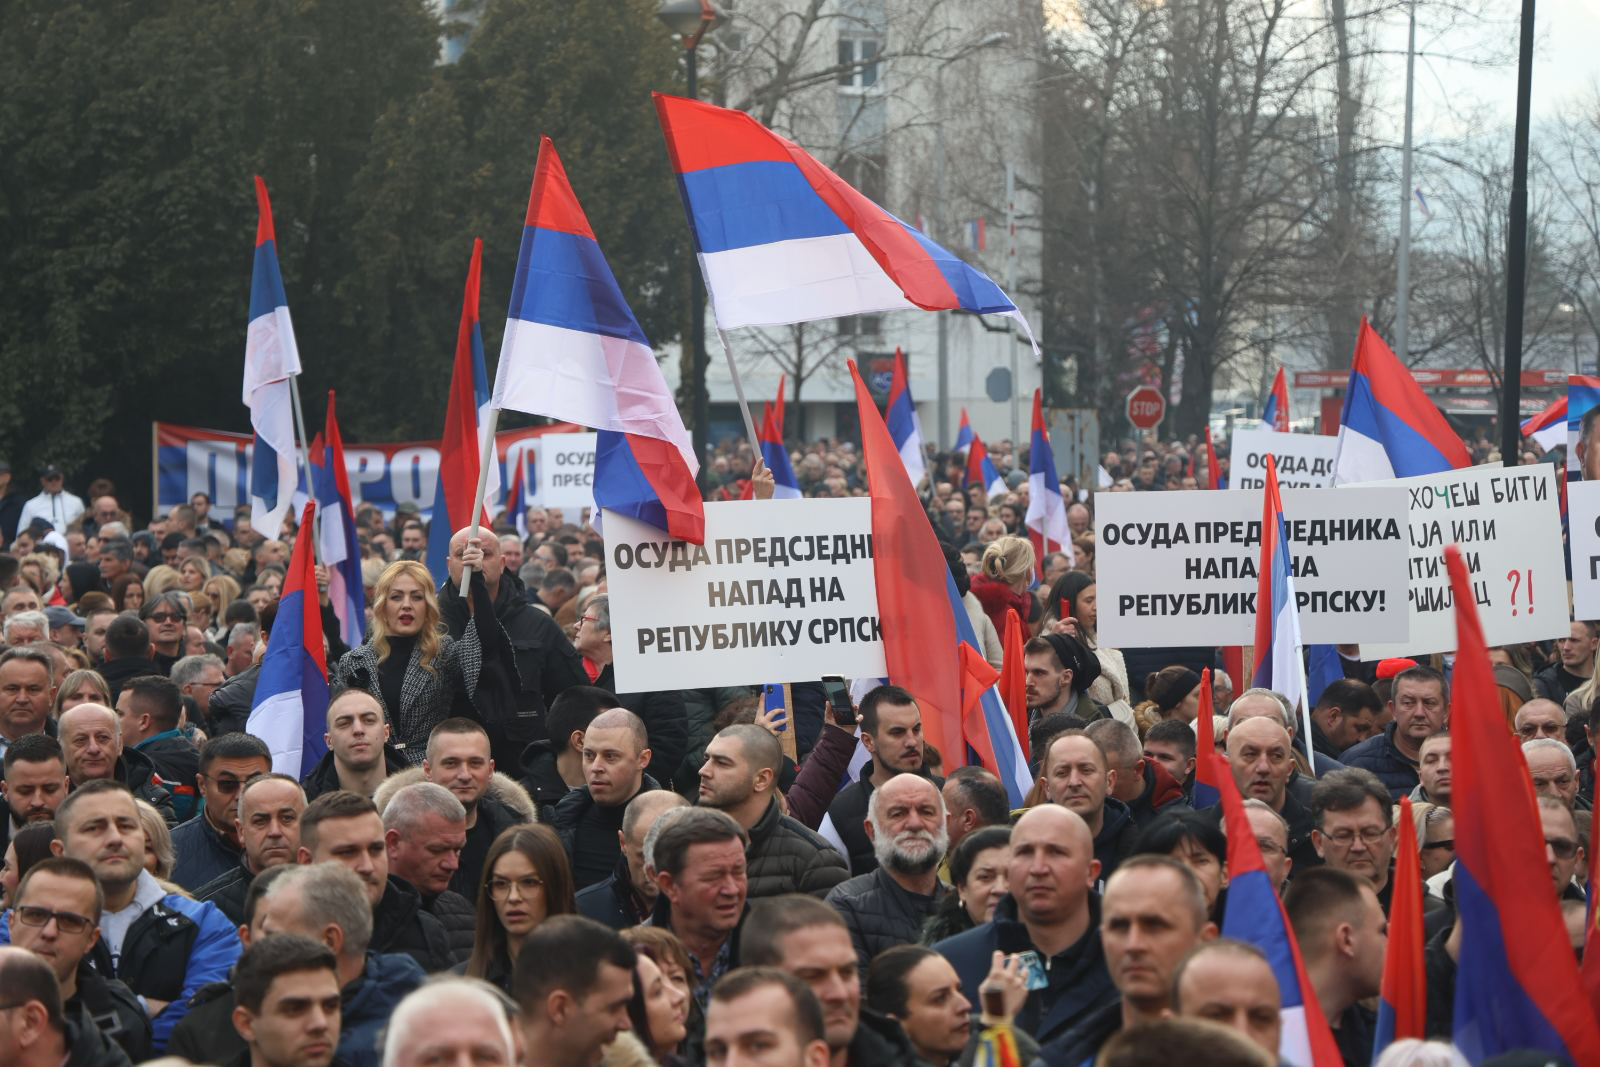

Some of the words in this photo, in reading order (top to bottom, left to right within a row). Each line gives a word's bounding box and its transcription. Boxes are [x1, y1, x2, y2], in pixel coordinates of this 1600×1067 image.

[1133, 401, 1160, 416] STOP
[555, 452, 595, 467] ОСУД
[552, 473, 594, 487] ПРЕС
[1409, 482, 1480, 510] ХОЧЕШ
[1491, 475, 1548, 503] БИТИ
[1102, 522, 1190, 549] ОСУДА
[1194, 518, 1401, 547] ПРЕДЈЕДНИКА
[1452, 519, 1496, 543] ИЛИ
[614, 541, 711, 572] ОСУДА
[1185, 556, 1259, 582] НАПА
[708, 578, 805, 608] НАПАД
[809, 576, 845, 602] НА
[1119, 594, 1257, 616] РЕПУБЛИК
[1295, 590, 1386, 613] РПСКУ!
[637, 619, 803, 654] РЕПУБЛИКУ
[808, 616, 883, 644] СРПСК
